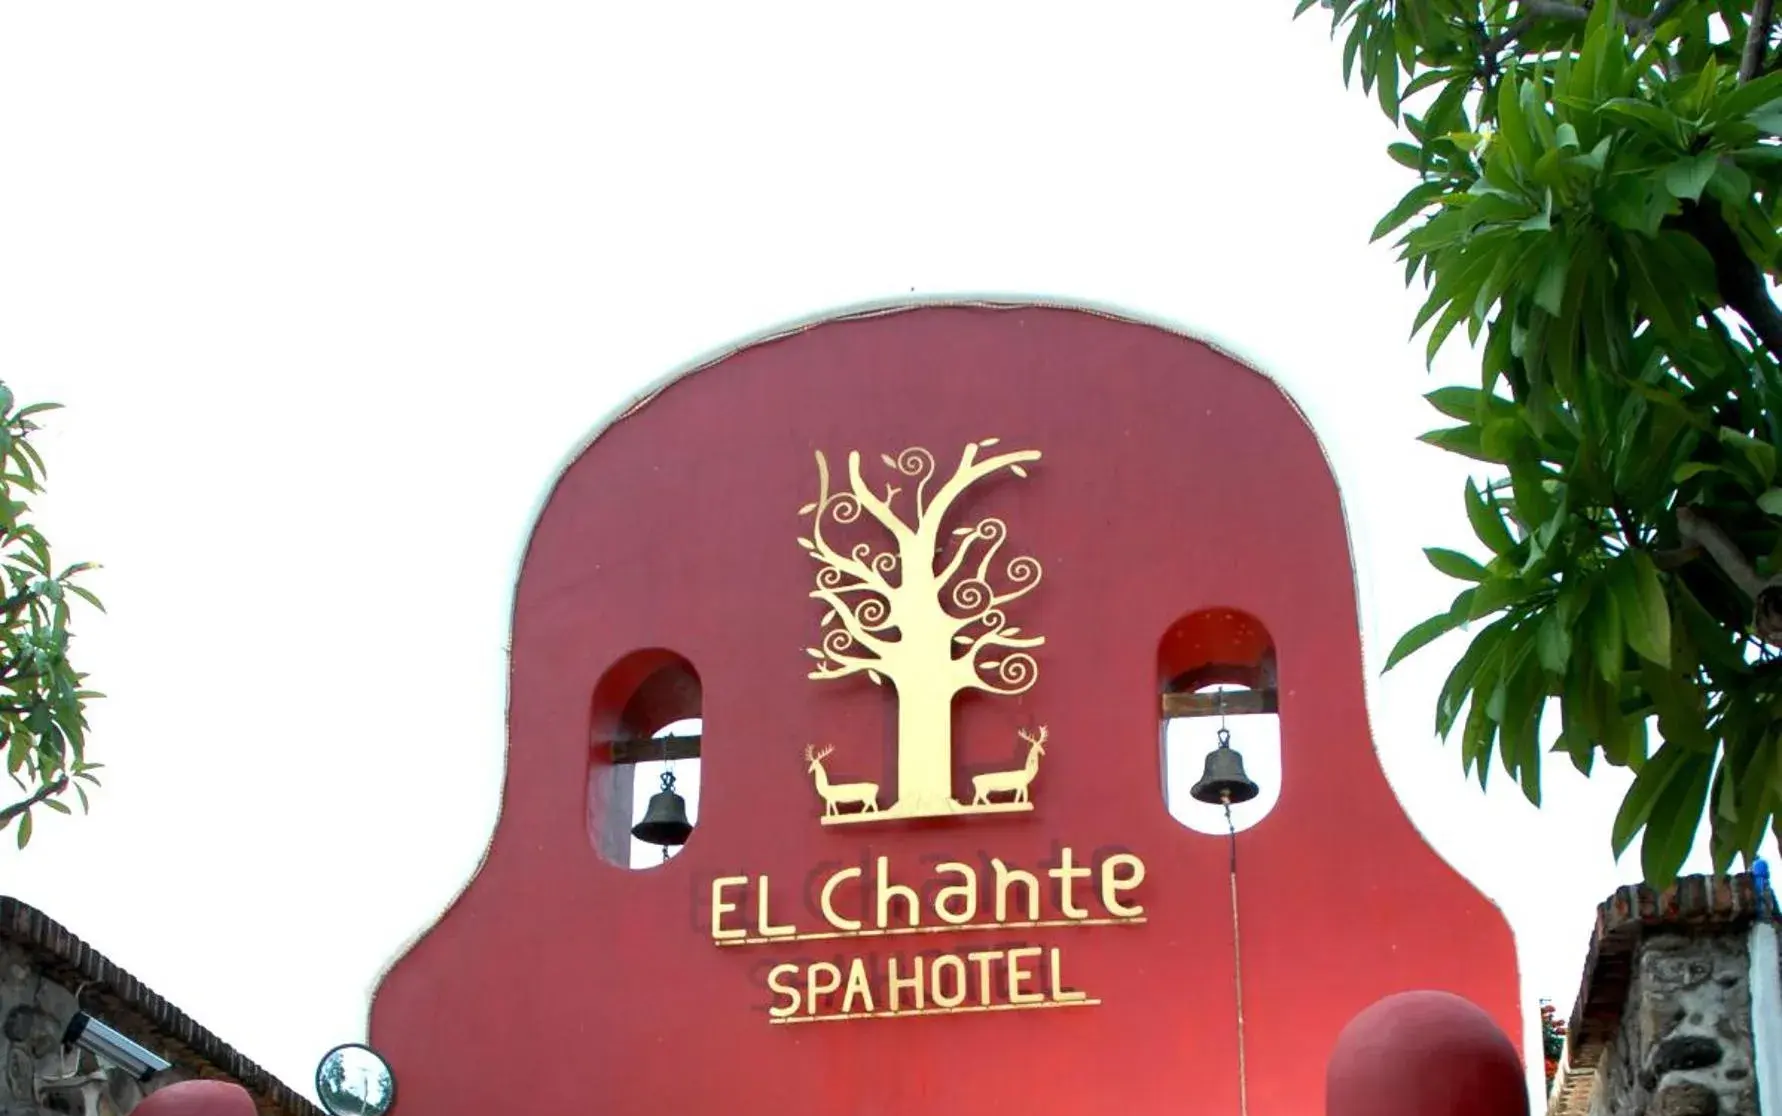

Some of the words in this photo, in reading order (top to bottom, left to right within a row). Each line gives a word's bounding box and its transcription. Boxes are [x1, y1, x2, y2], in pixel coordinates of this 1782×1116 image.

[711, 875, 797, 939] EL
[767, 957, 874, 1018] SPA
[888, 947, 1086, 1013] HOTEL
